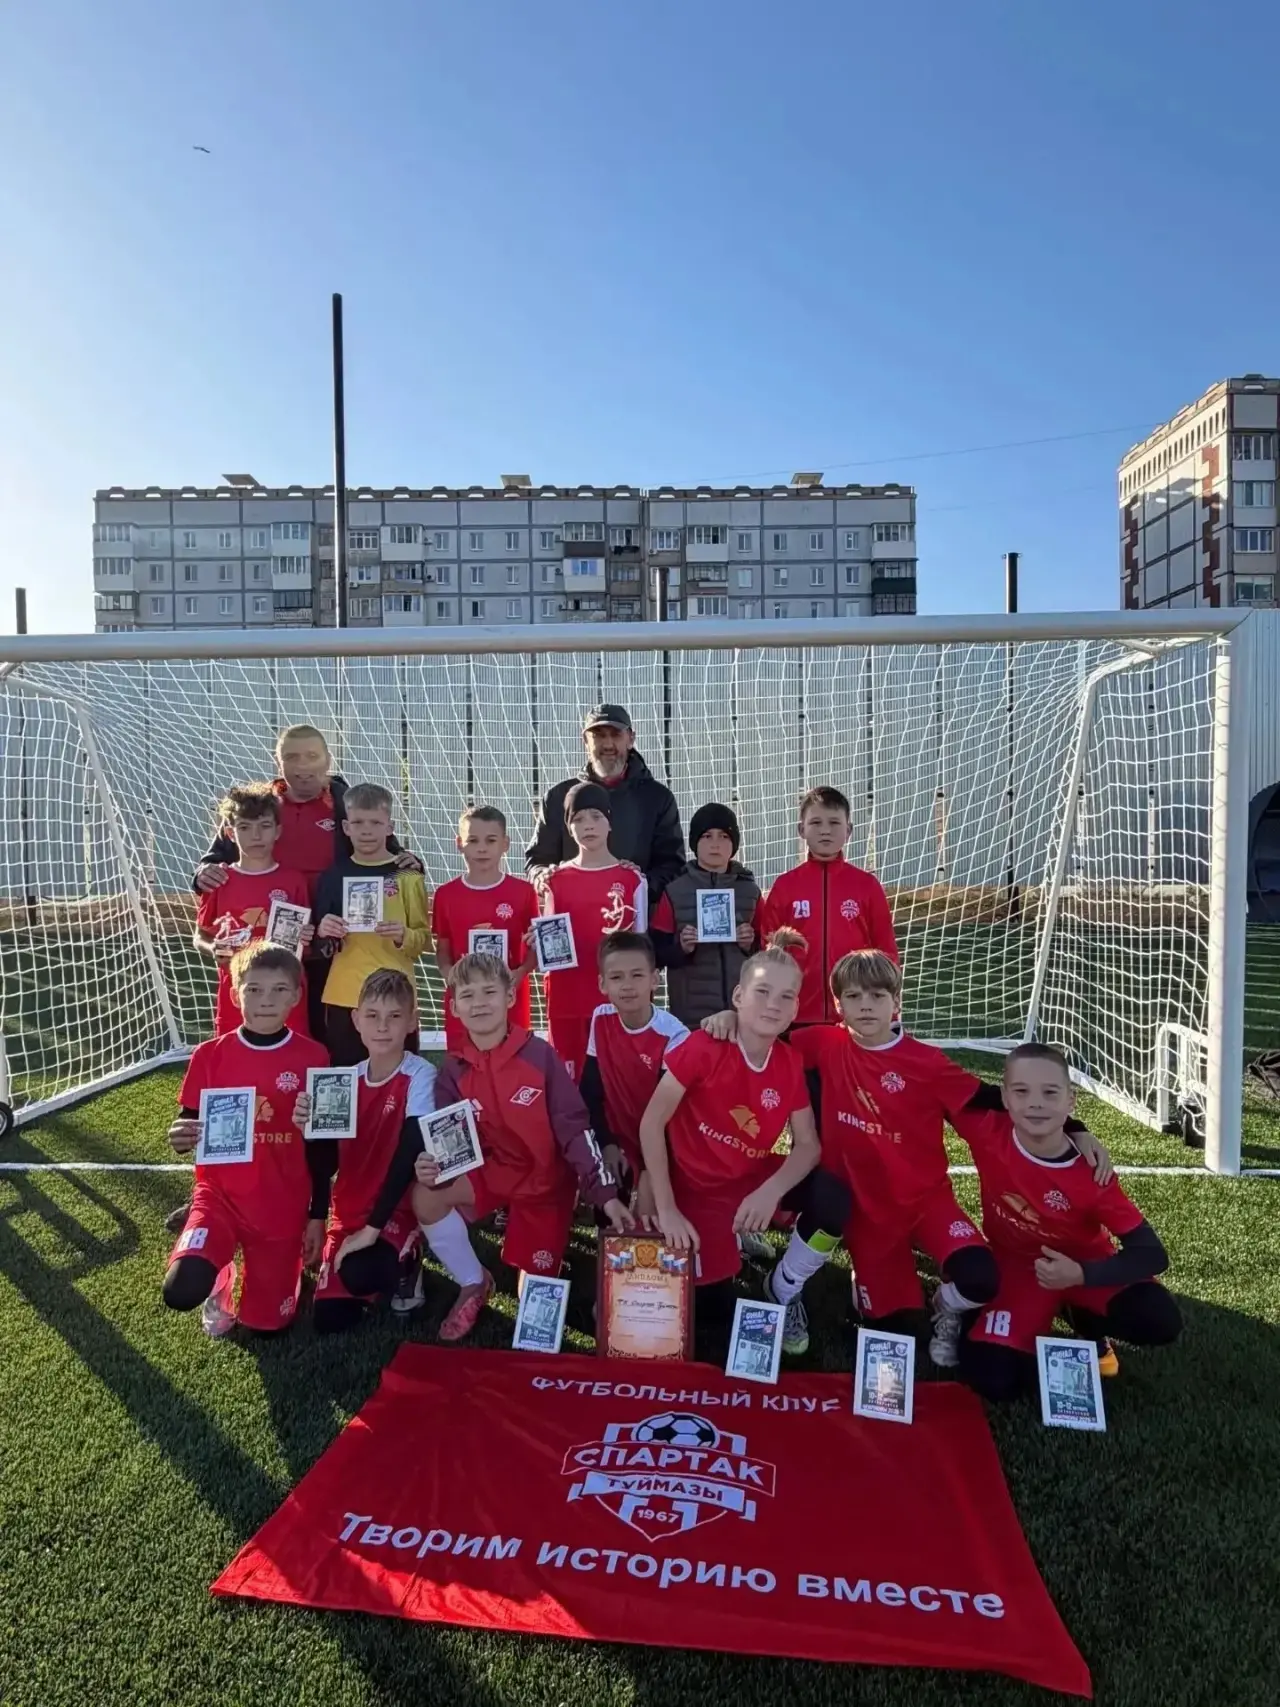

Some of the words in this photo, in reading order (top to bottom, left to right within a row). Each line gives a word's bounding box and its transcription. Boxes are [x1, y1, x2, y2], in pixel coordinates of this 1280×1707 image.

[792, 899, 811, 919] 29
[837, 1110, 902, 1144] KINGSTE
[985, 1310, 1012, 1337] 18
[531, 1375, 751, 1409] ФУТБОЛЬНЫЙ
[574, 1445, 764, 1486] СПАРТАК
[608, 1476, 723, 1502] ТУЙМАЗЫ
[637, 1508, 680, 1524] 1967
[338, 1512, 523, 1560] Творим
[536, 1541, 777, 1593] историю
[797, 1573, 1005, 1619] вместе
